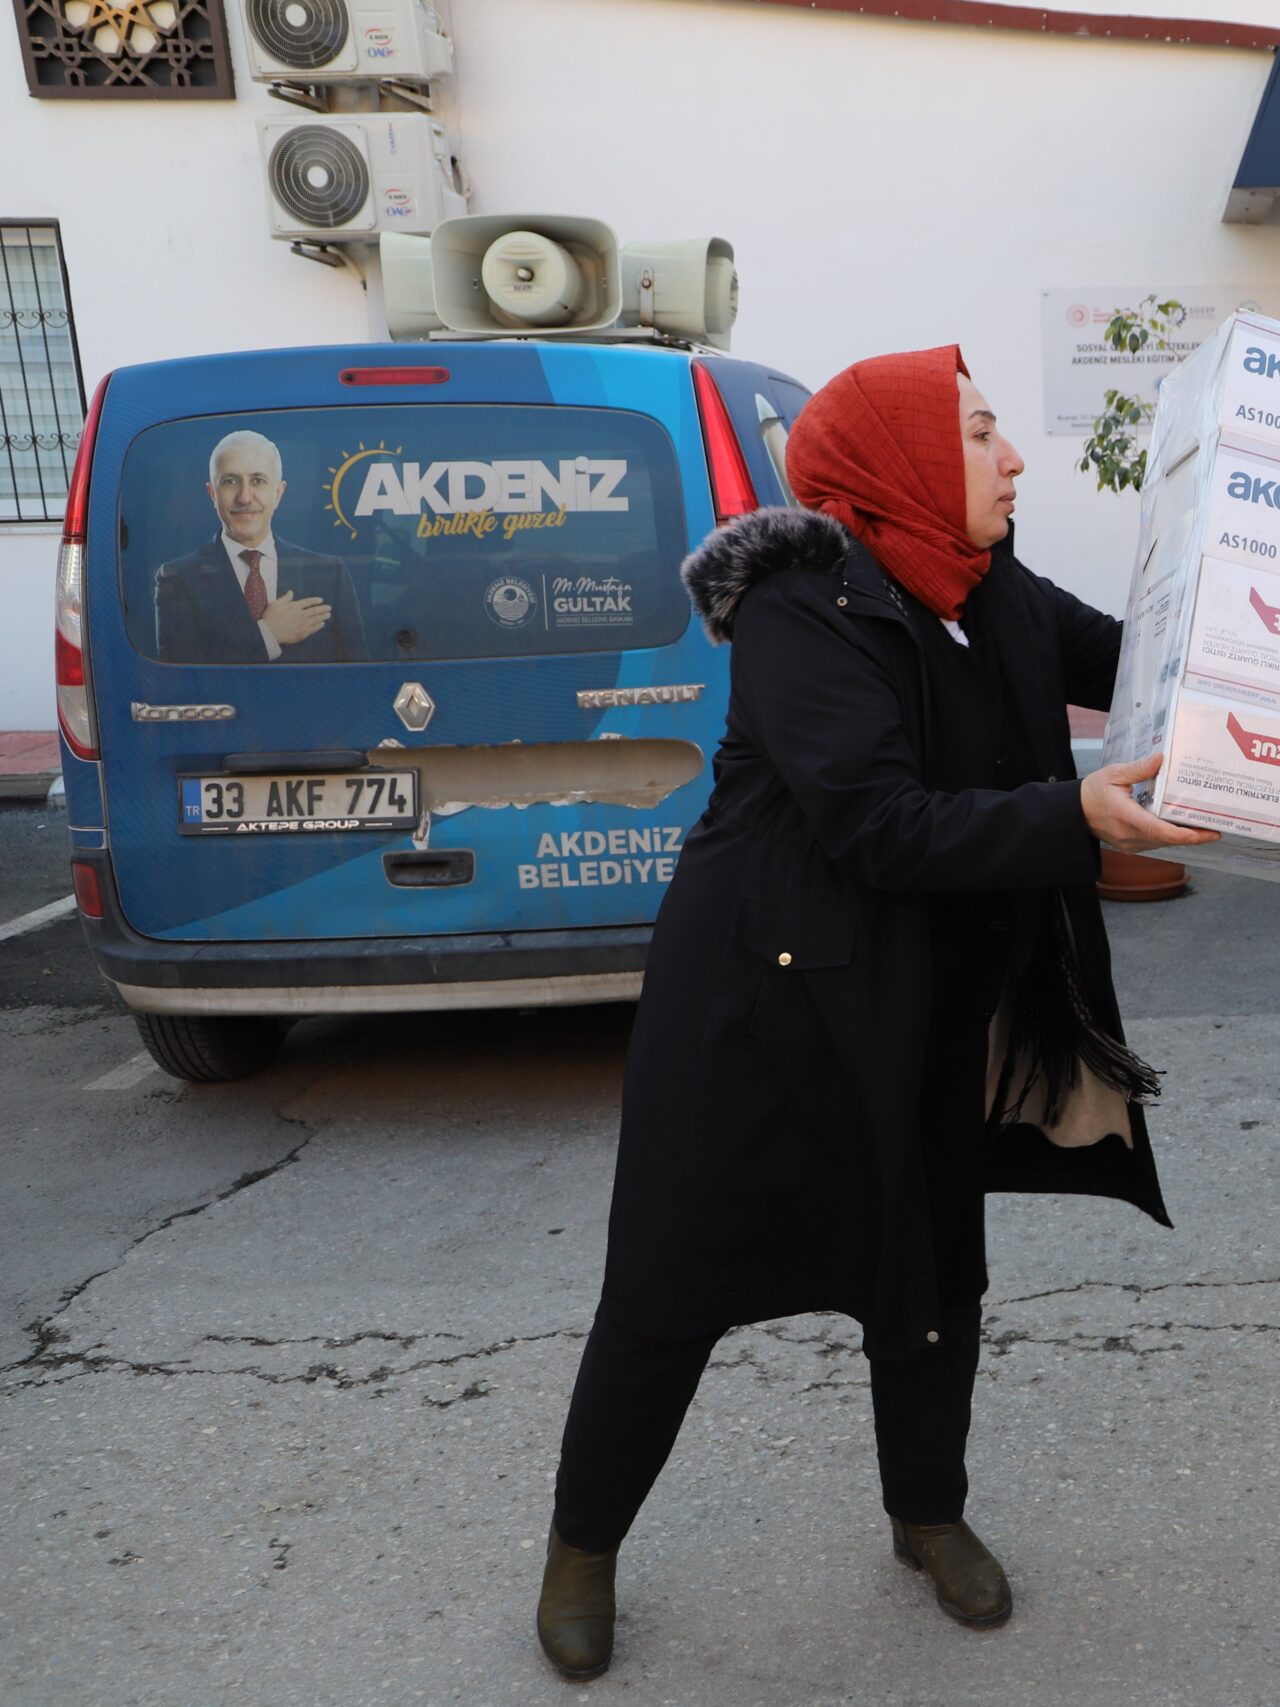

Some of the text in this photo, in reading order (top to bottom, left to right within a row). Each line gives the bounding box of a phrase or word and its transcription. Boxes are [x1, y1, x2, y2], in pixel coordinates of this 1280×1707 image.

[416, 509, 498, 539] birlikte
[1219, 531, 1277, 559] AS1000
[1228, 652, 1259, 666] QUARTZ
[576, 684, 705, 708] RENAULT
[131, 702, 236, 722] Kangoo
[185, 777, 407, 819] TR 33 AKF 774
[1202, 780, 1235, 794] QUARTZ
[236, 819, 360, 832] AKTEPE GROUP
[518, 857, 681, 889] BELEDİYE
